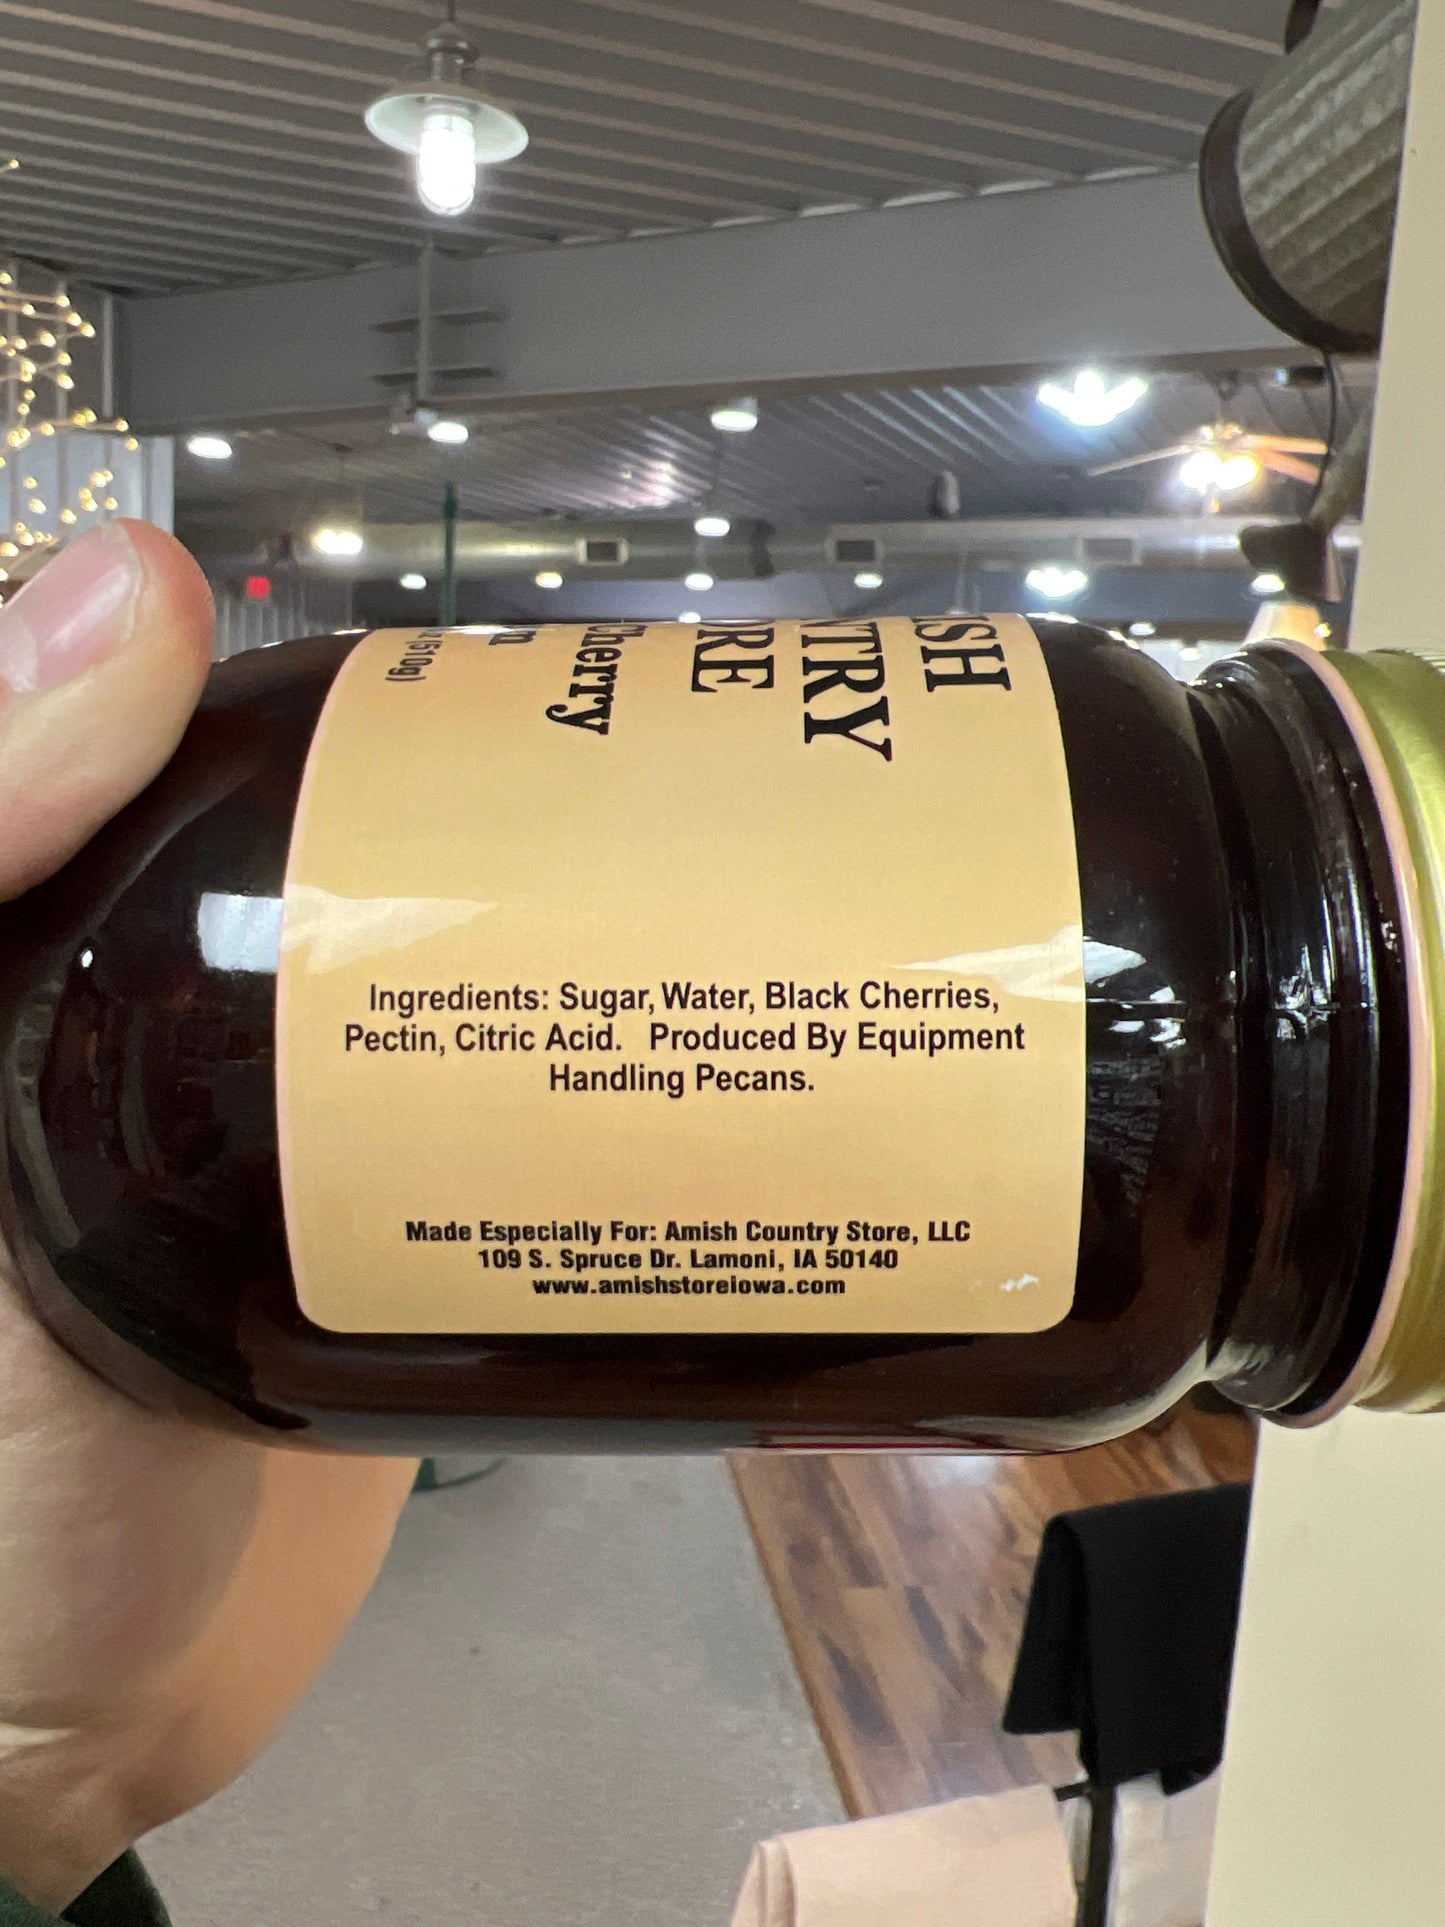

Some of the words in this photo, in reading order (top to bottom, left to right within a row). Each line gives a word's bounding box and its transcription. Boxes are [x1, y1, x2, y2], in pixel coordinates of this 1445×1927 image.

[545, 623, 648, 736] Cherry
[370, 982, 549, 1019] Ingredients:
[559, 981, 656, 1018] Sugar,
[661, 981, 756, 1015] Water,
[765, 980, 850, 1010] Black
[859, 980, 1000, 1014] Cherries,
[344, 1022, 446, 1057] Pectin,
[455, 1022, 536, 1052] Citric
[544, 1021, 623, 1051] Acid.
[649, 1021, 796, 1051] Produced
[806, 1021, 848, 1058] By
[857, 1020, 1026, 1058] Equipment
[549, 1062, 685, 1099] Handling
[695, 1062, 815, 1092] Pecans.
[405, 1220, 473, 1242] Made
[479, 1220, 604, 1246] Especially
[610, 1220, 658, 1242] For:
[664, 1220, 738, 1242] Amish
[745, 1220, 840, 1246] Country
[845, 1220, 920, 1246] Store,
[927, 1220, 972, 1242] LLC
[477, 1248, 523, 1269] 109
[528, 1248, 553, 1269] S.
[559, 1248, 643, 1273] Spruce
[649, 1248, 683, 1269] Dr.
[689, 1248, 786, 1273] Lamoni,
[793, 1248, 818, 1269] IA
[824, 1248, 900, 1270] 50140
[531, 1274, 847, 1295] www.amishstoreiowa.com
